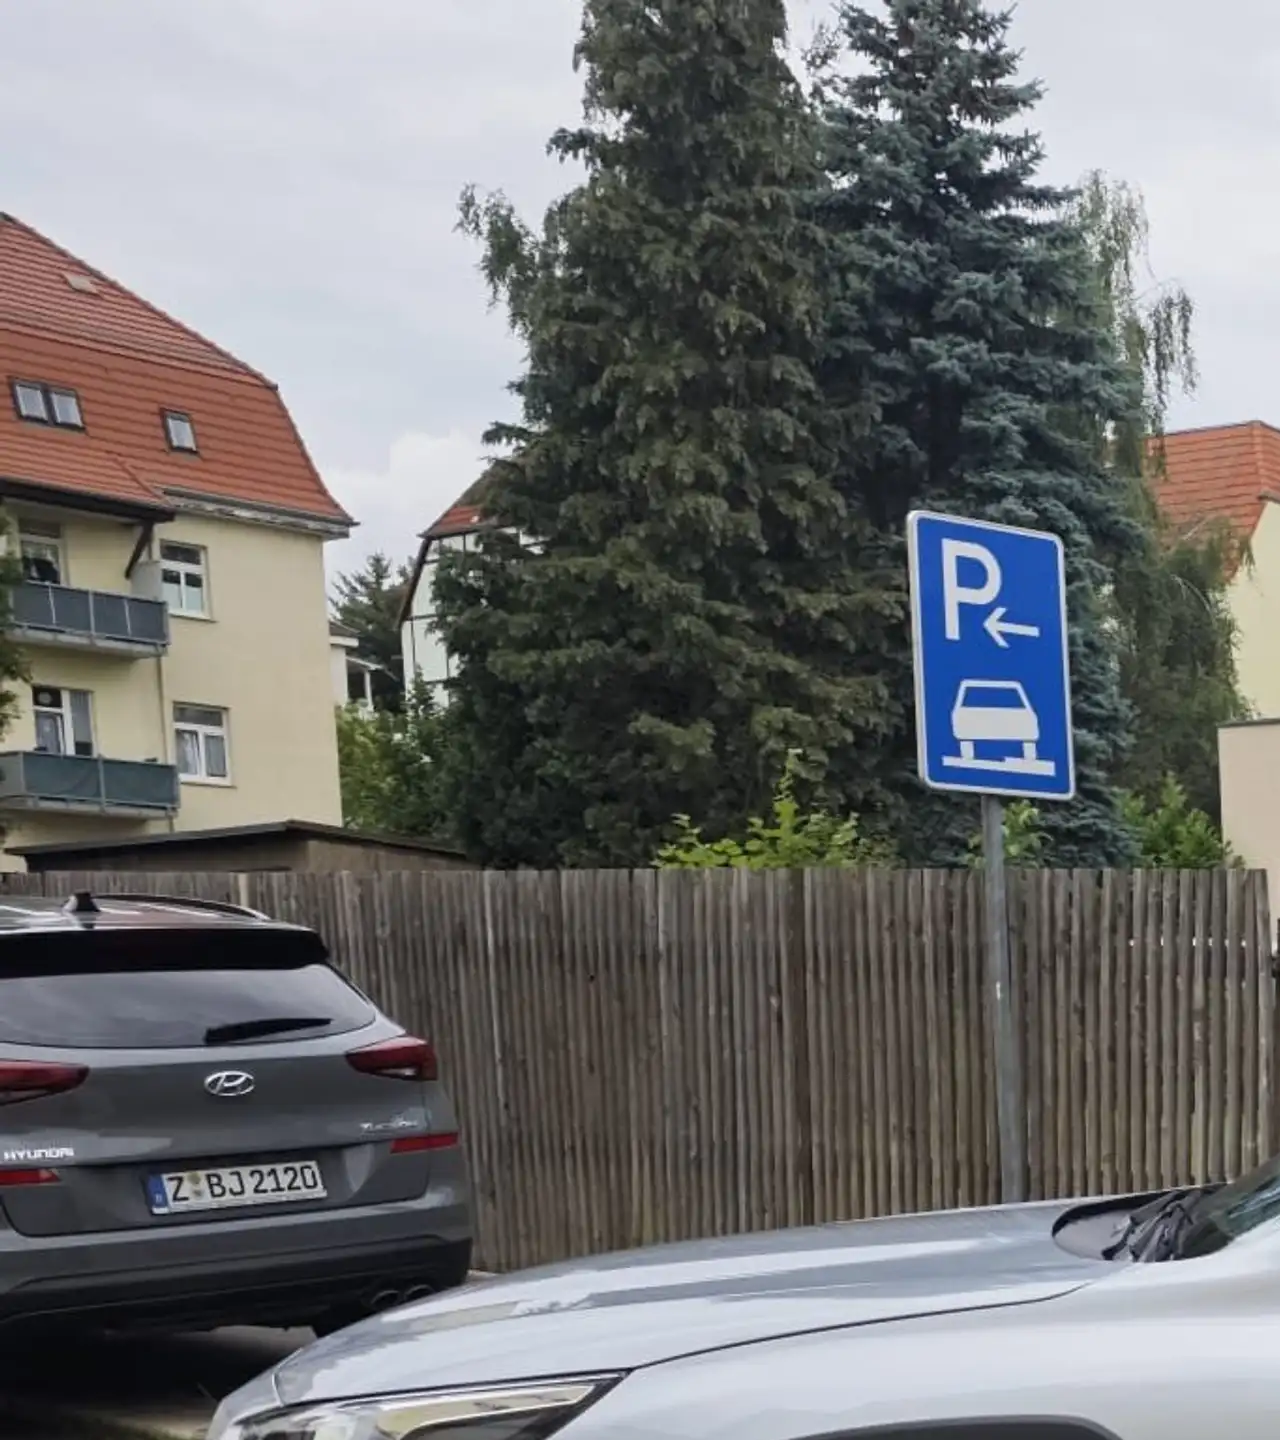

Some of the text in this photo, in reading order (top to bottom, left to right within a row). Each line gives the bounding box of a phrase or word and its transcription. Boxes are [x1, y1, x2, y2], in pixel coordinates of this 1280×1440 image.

[942, 537, 1001, 641] P
[168, 1176, 189, 1202] Z
[252, 1164, 319, 1193] 2120
